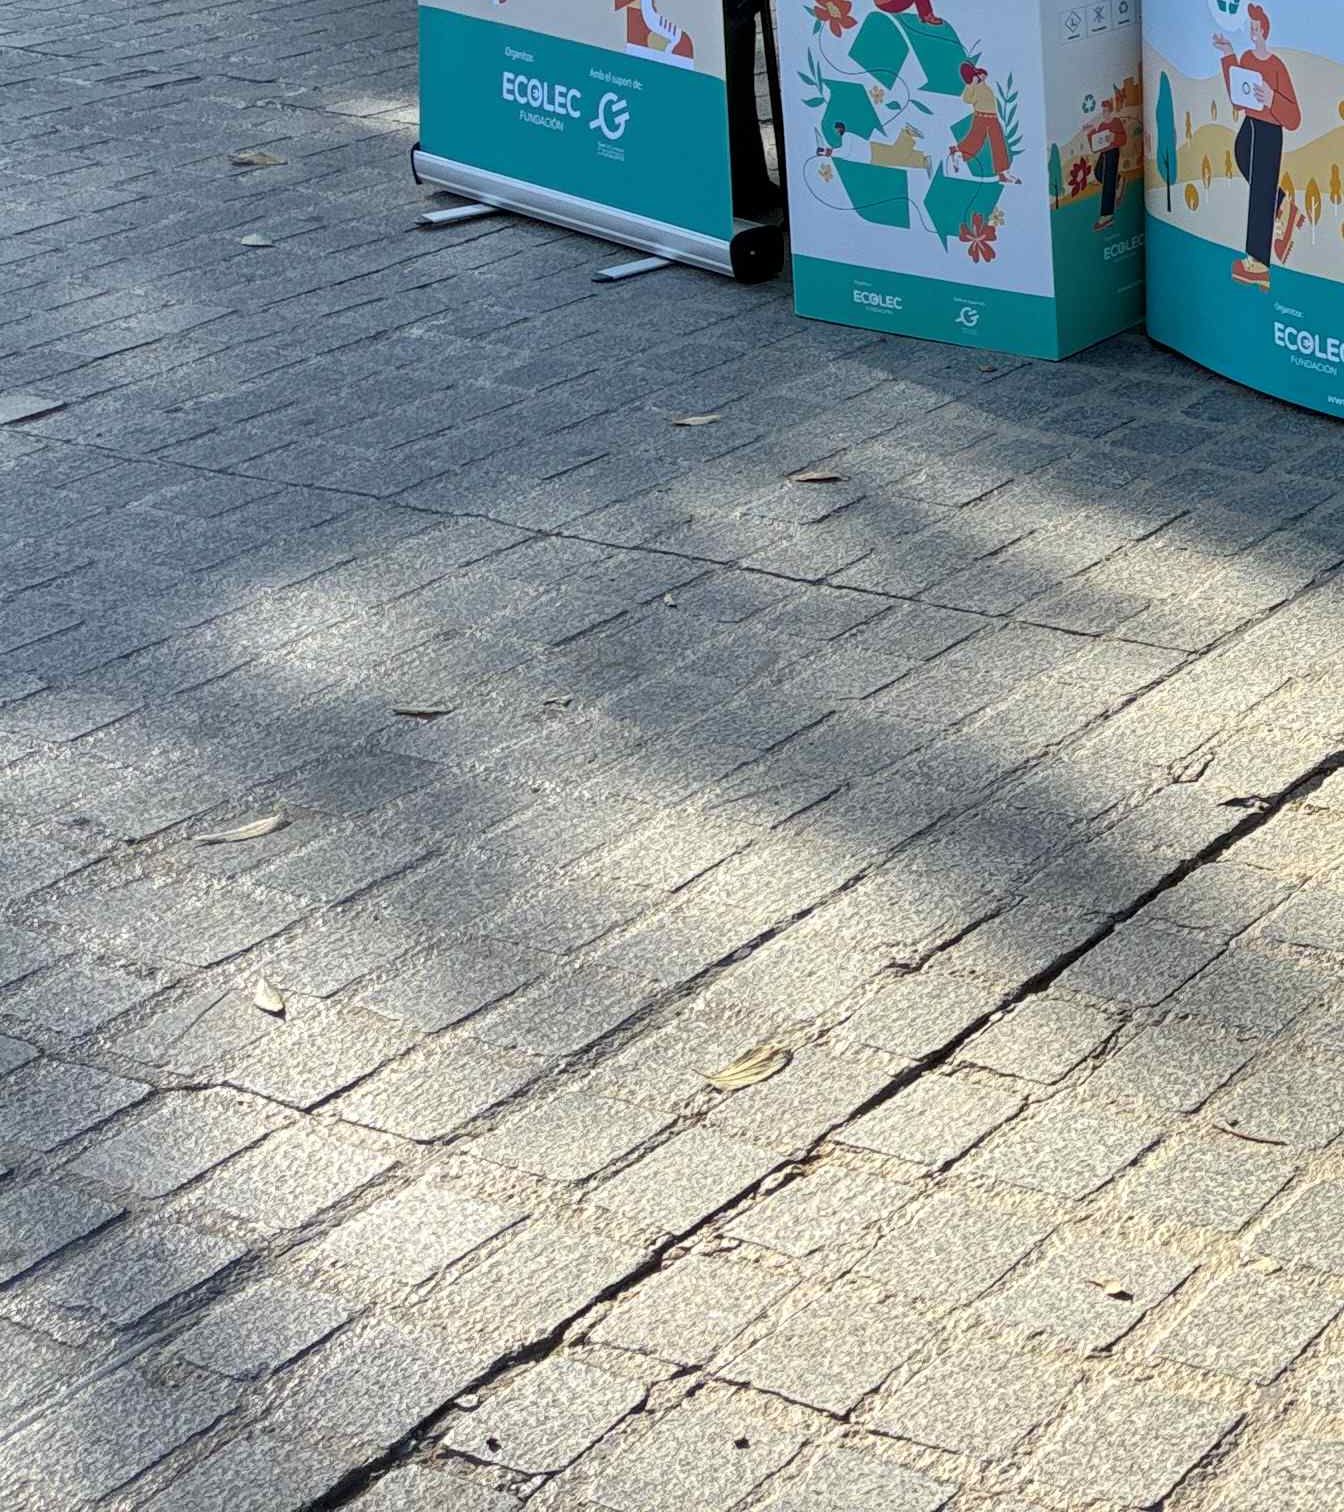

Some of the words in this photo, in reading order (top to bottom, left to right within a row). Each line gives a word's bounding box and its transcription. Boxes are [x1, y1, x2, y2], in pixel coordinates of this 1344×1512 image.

[502, 71, 581, 119] ECOLEC
[519, 110, 564, 131] FUNDACIÓN
[853, 290, 902, 309] ECOLEC
